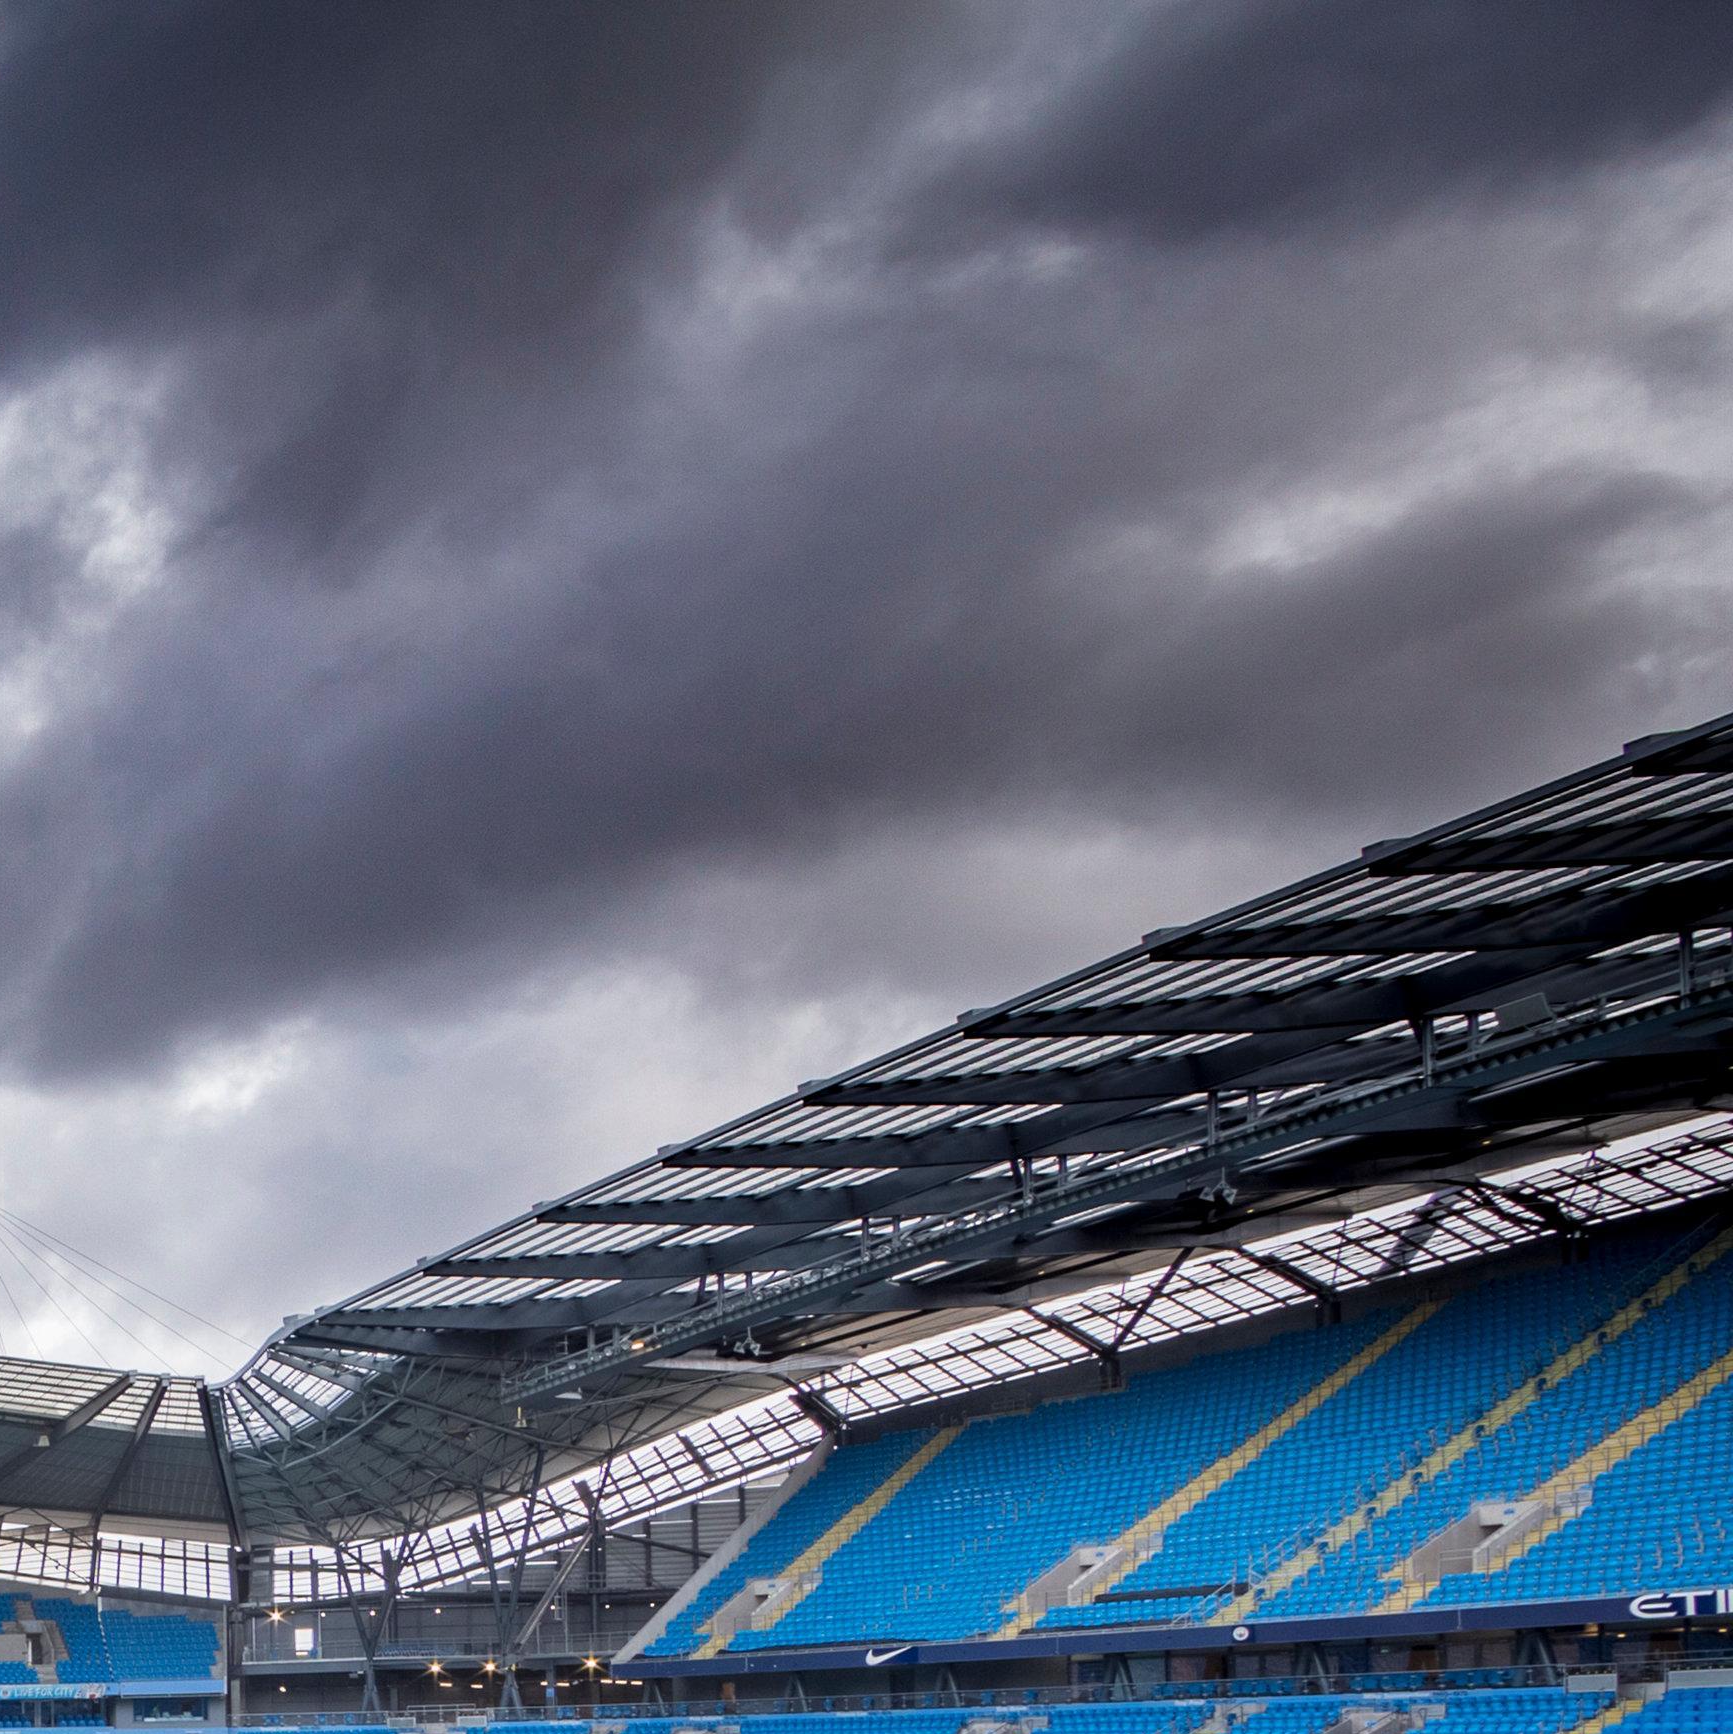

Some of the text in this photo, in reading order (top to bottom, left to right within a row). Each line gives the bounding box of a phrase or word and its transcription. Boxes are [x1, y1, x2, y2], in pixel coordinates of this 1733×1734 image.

[14, 1688, 73, 1697] LIVE FOR CITY
